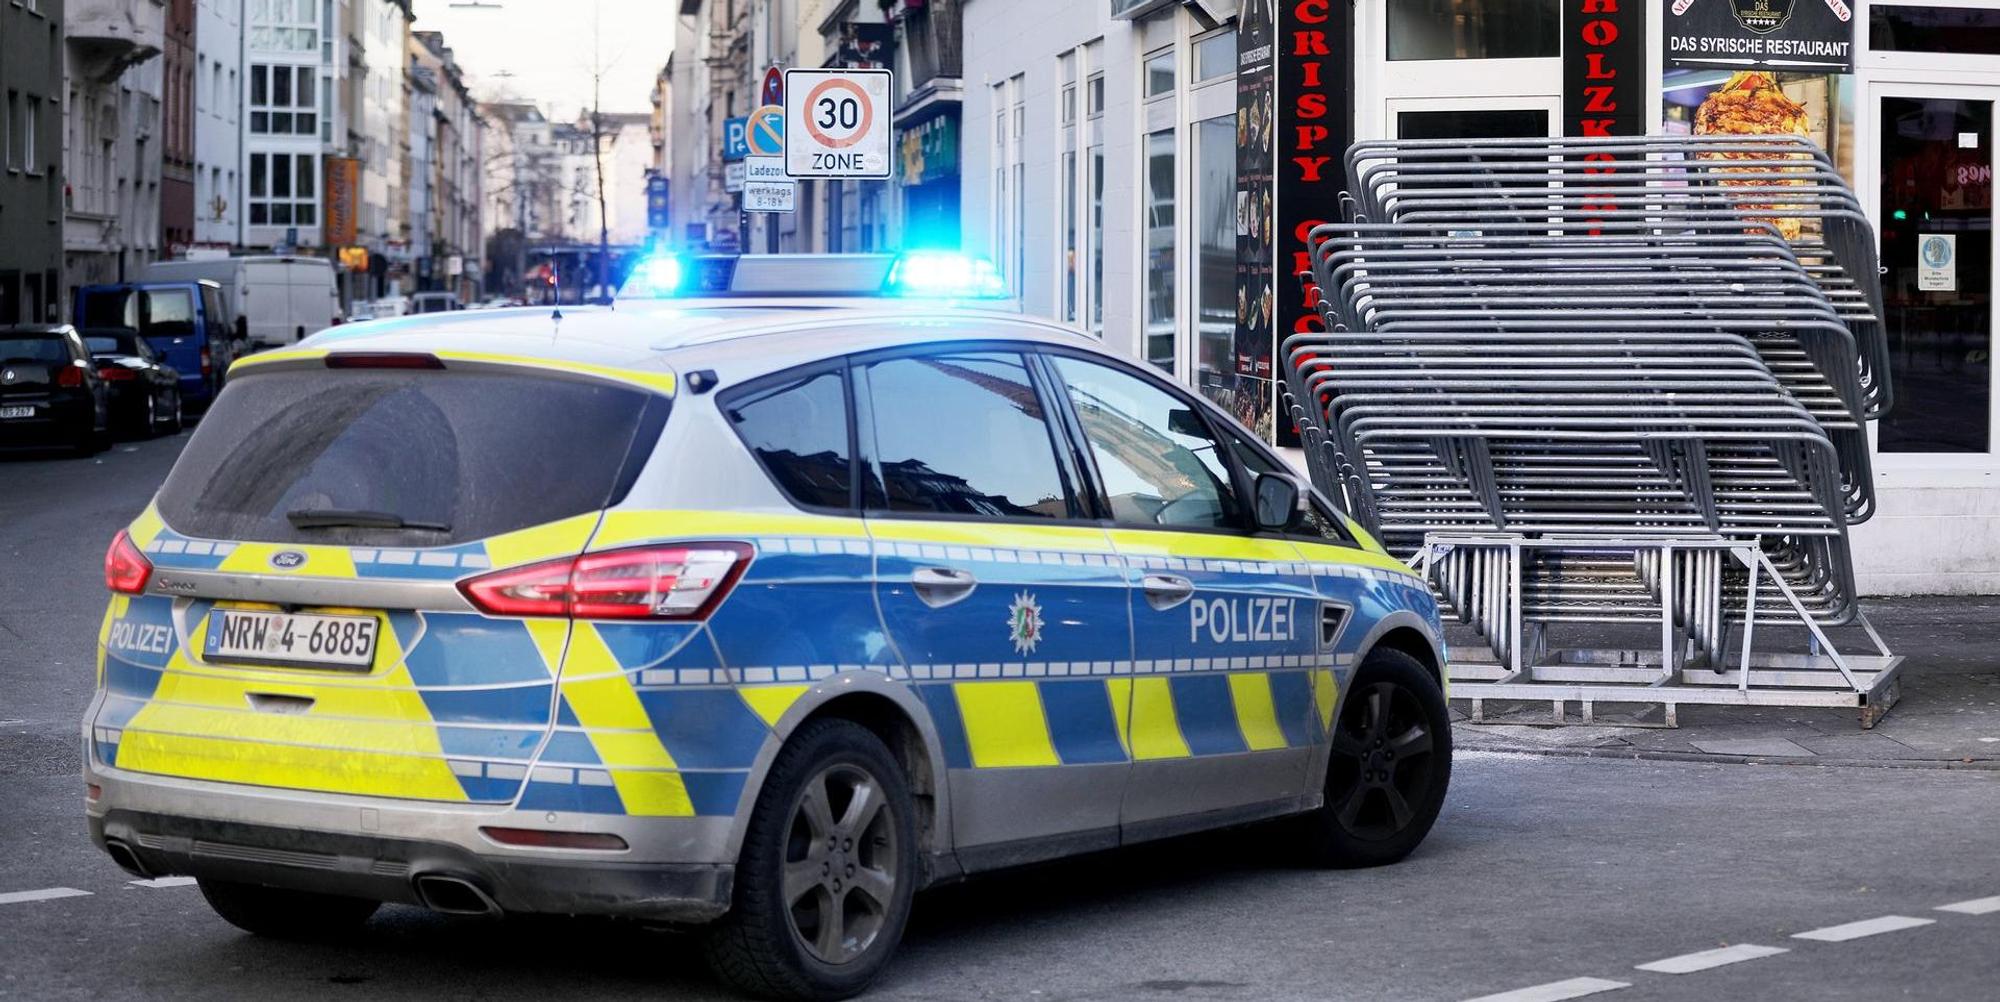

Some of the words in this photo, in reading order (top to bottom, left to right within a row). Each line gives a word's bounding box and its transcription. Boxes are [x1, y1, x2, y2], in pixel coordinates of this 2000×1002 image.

[1754, 2, 1769, 11] DAS
[1670, 36, 1697, 51] DAS
[1700, 38, 1763, 53] SYRISCHE
[1766, 40, 1849, 56] RESTAURANT
[1293, 0, 1331, 182] CRISPY
[818, 98, 858, 130] 30
[812, 154, 864, 170] ZONE
[748, 187, 792, 197] werktags
[275, 553, 300, 566] Ford
[220, 615, 270, 651] NRW
[1190, 598, 1296, 643] POLIZEI
[109, 622, 173, 654] POLIZEI
